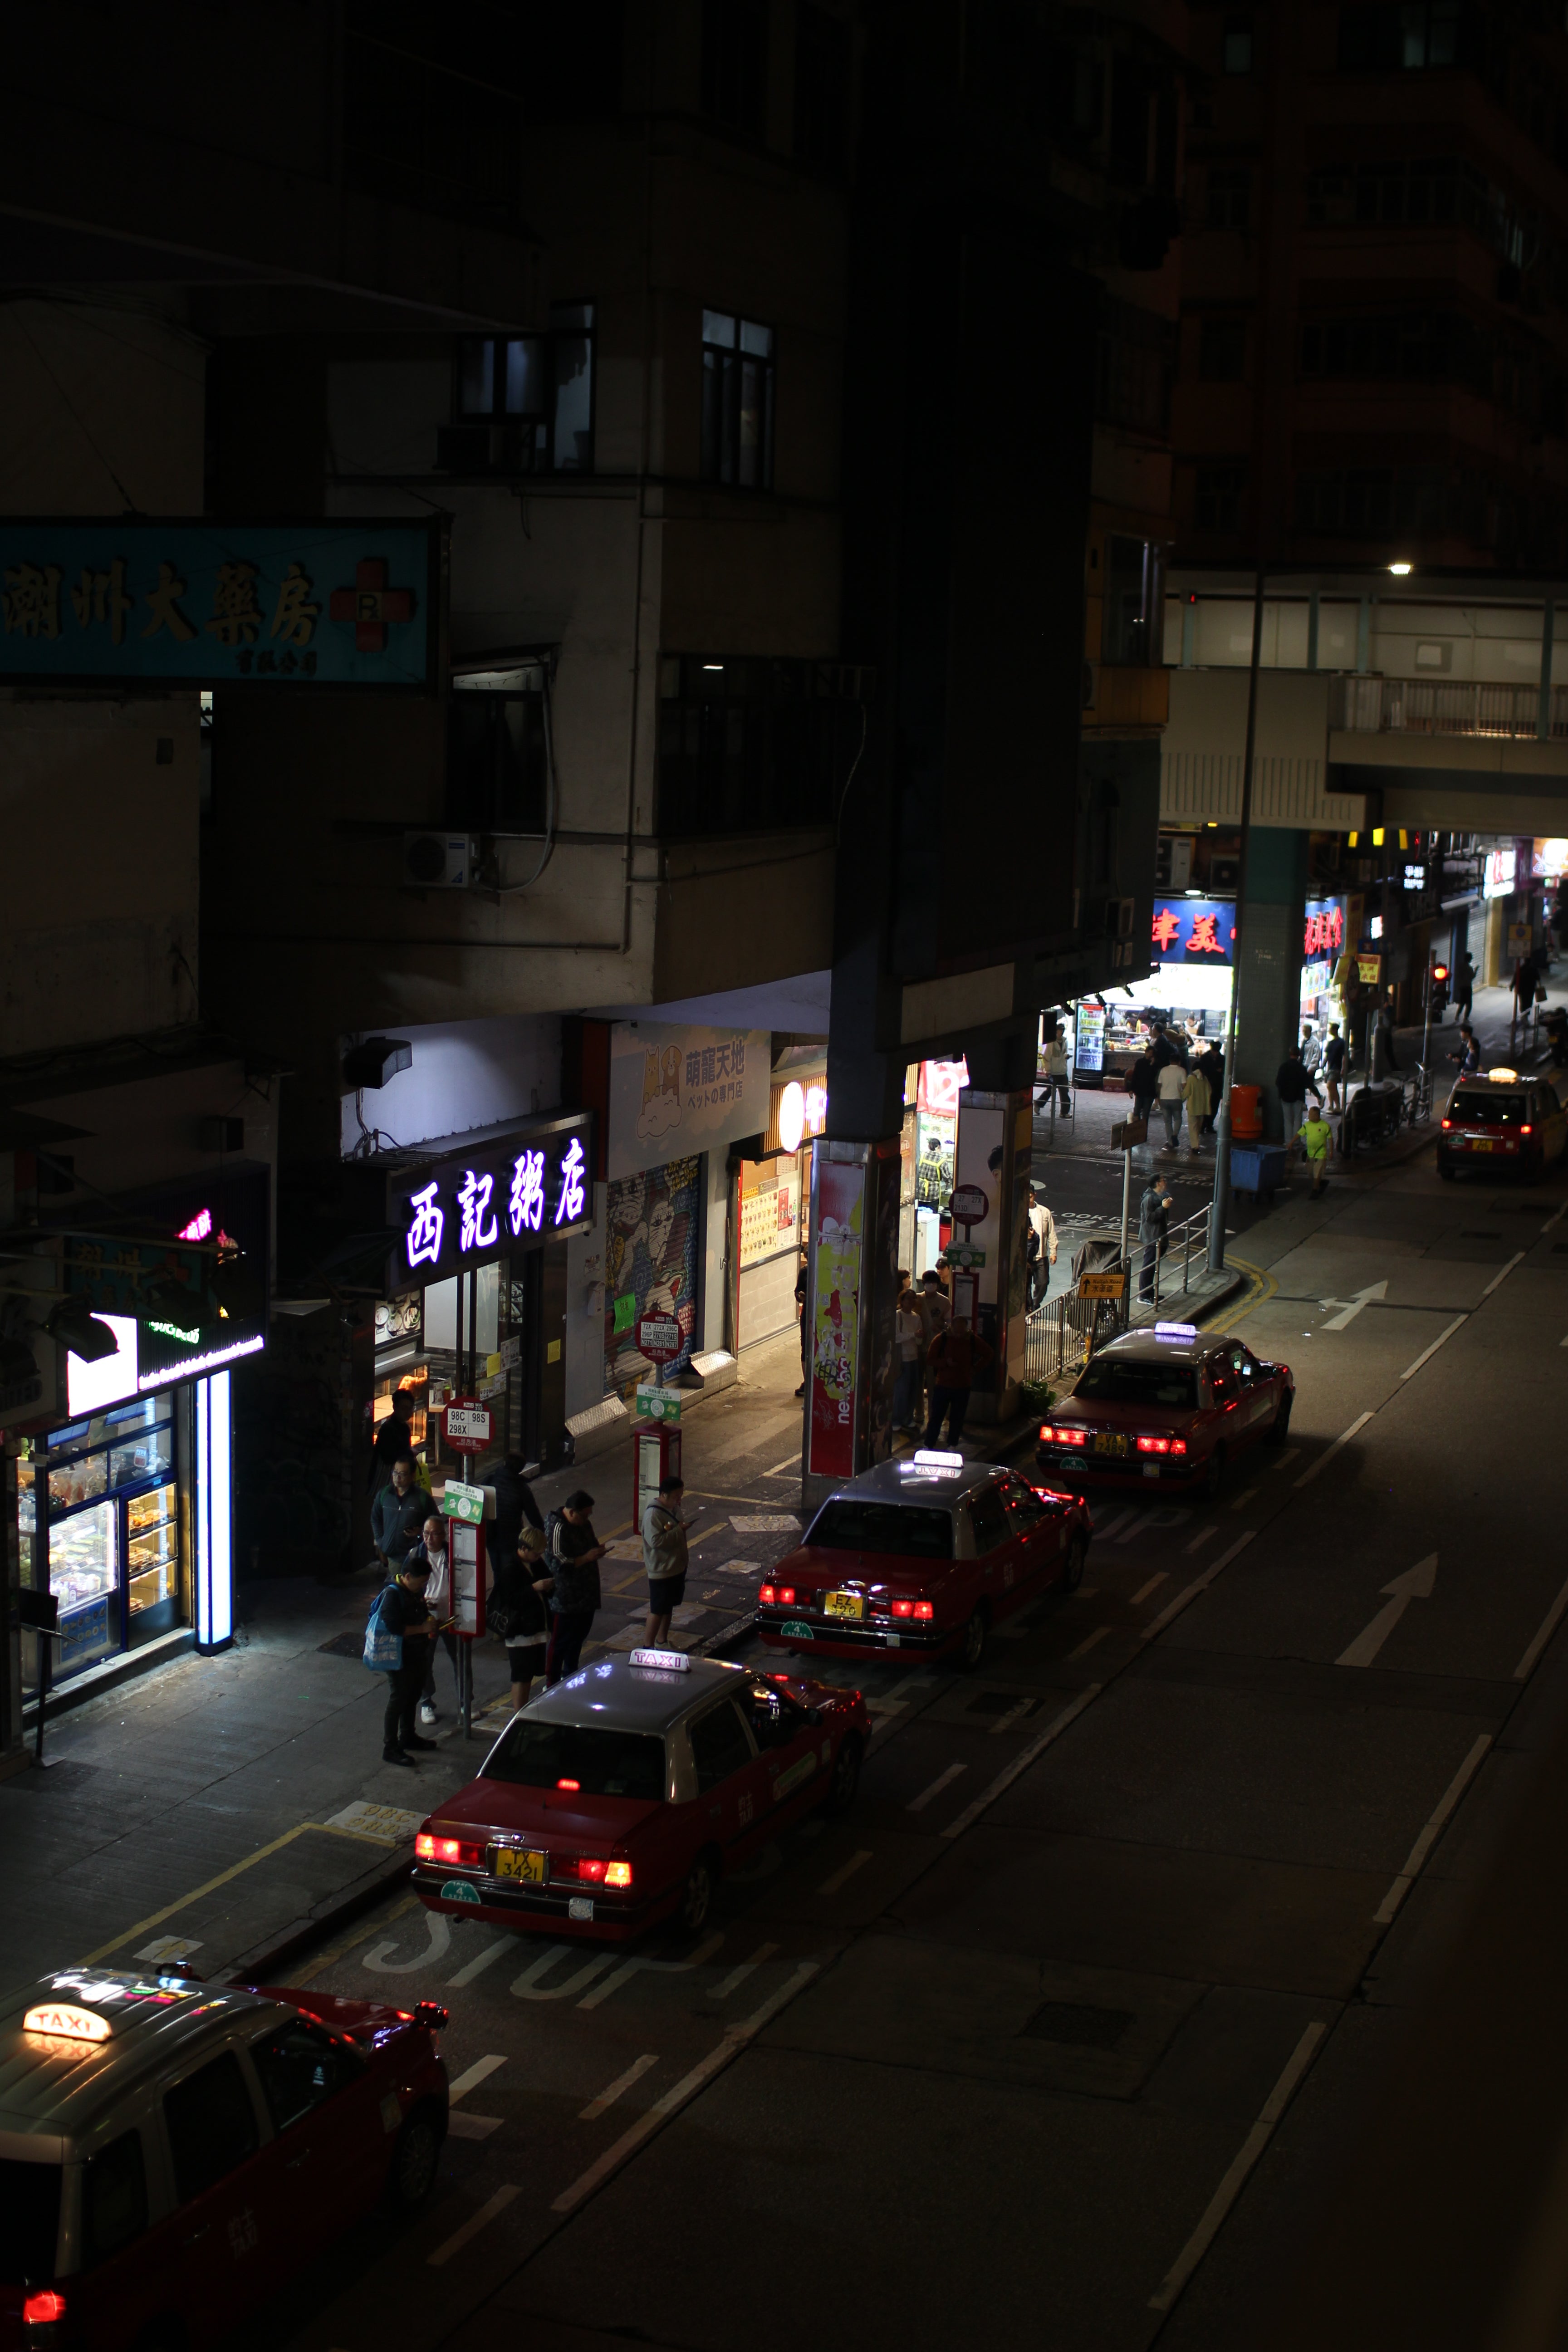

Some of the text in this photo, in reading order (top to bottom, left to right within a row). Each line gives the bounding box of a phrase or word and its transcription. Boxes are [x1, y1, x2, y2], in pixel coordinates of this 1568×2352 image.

[1, 556, 319, 647] 潮州大藥房
[235, 649, 317, 676] 有限公司
[686, 1039, 745, 1088] 萌寵天地
[407, 1137, 586, 1268] 西記粥店
[1159, 1324, 1191, 1334] TAXI
[451, 1411, 486, 1423] 98C 98S
[449, 1424, 467, 1435] 298X
[1105, 1434, 1117, 1444] VA
[1098, 1442, 1125, 1453] 7489
[835, 1593, 853, 1606] EZ
[832, 1604, 856, 1617] 320
[635, 1651, 681, 1667] TAXI
[511, 1850, 530, 1866] TX
[503, 1862, 538, 1881] 3421
[448, 1893, 473, 1902] SEATS
[456, 1887, 464, 1896] 4
[34, 2013, 90, 2033] TAXI
